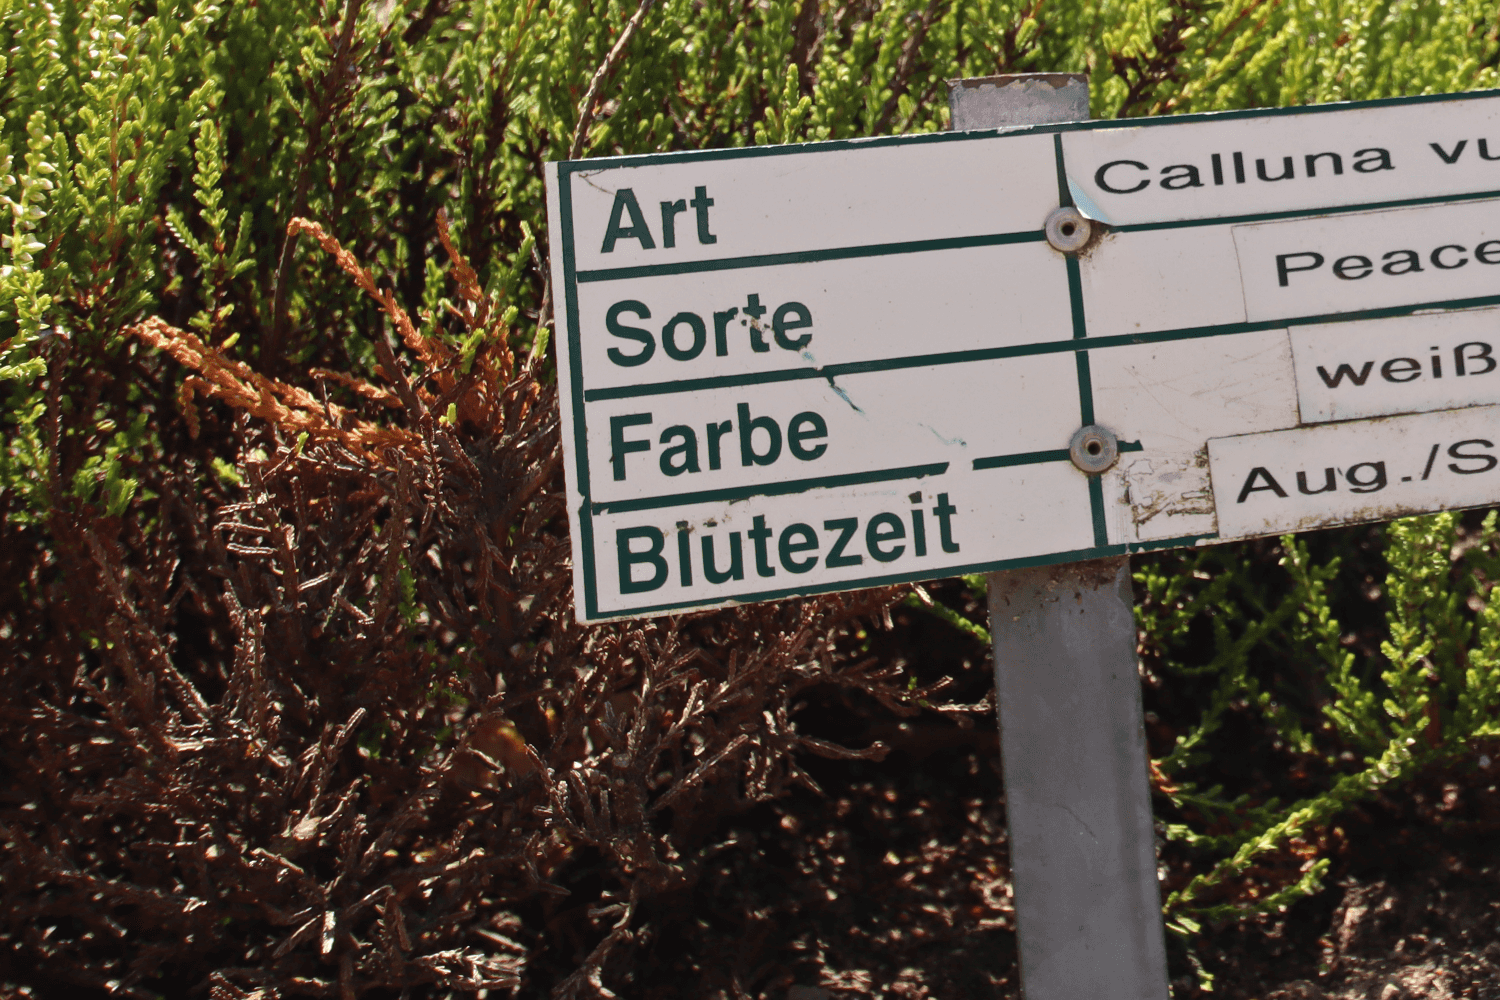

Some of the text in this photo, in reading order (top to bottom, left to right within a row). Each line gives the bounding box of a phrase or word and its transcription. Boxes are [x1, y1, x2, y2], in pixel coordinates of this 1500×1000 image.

[1094, 147, 1396, 195] Calluna
[600, 185, 718, 254] Art
[605, 293, 814, 368] Sorte
[1316, 341, 1498, 389] weiß
[609, 402, 830, 482] Farbe
